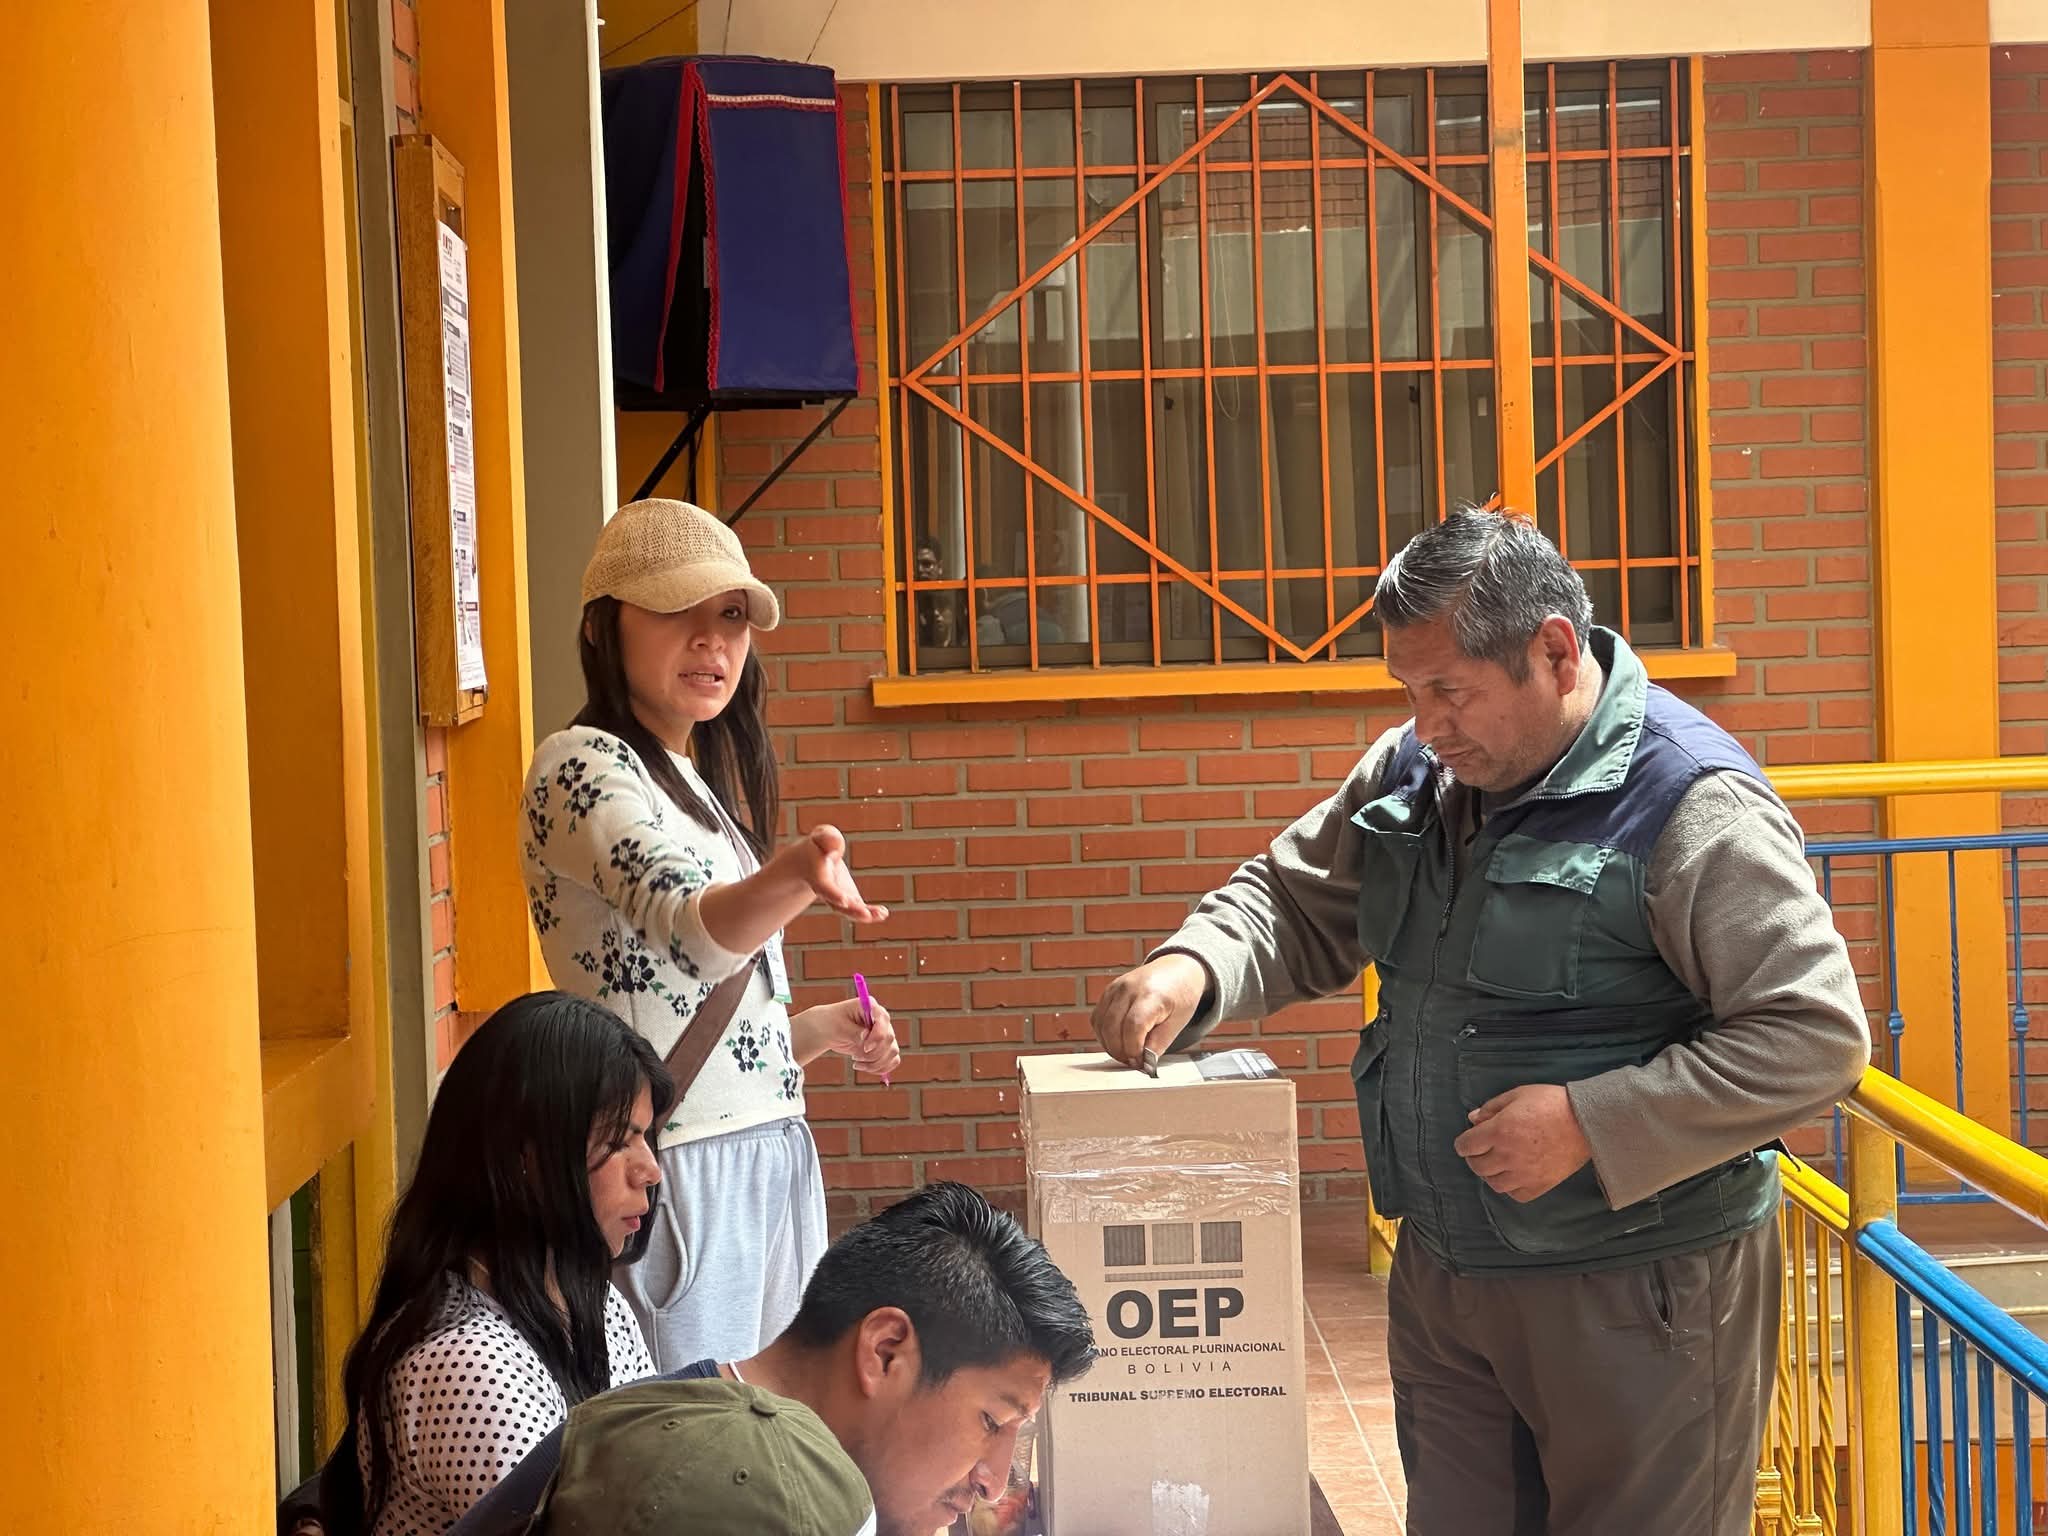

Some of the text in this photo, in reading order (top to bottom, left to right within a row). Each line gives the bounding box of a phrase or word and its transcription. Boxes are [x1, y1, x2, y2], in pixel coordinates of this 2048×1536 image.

[1106, 1287, 1245, 1340] OEP
[1121, 1345, 1190, 1356] ELECTORAL
[1192, 1342, 1286, 1354] PLURINACIONAL
[1128, 1360, 1232, 1375] BOLIVIA
[1069, 1386, 1287, 1403] TRIBUNAL SUPREMO ELECTORAL
